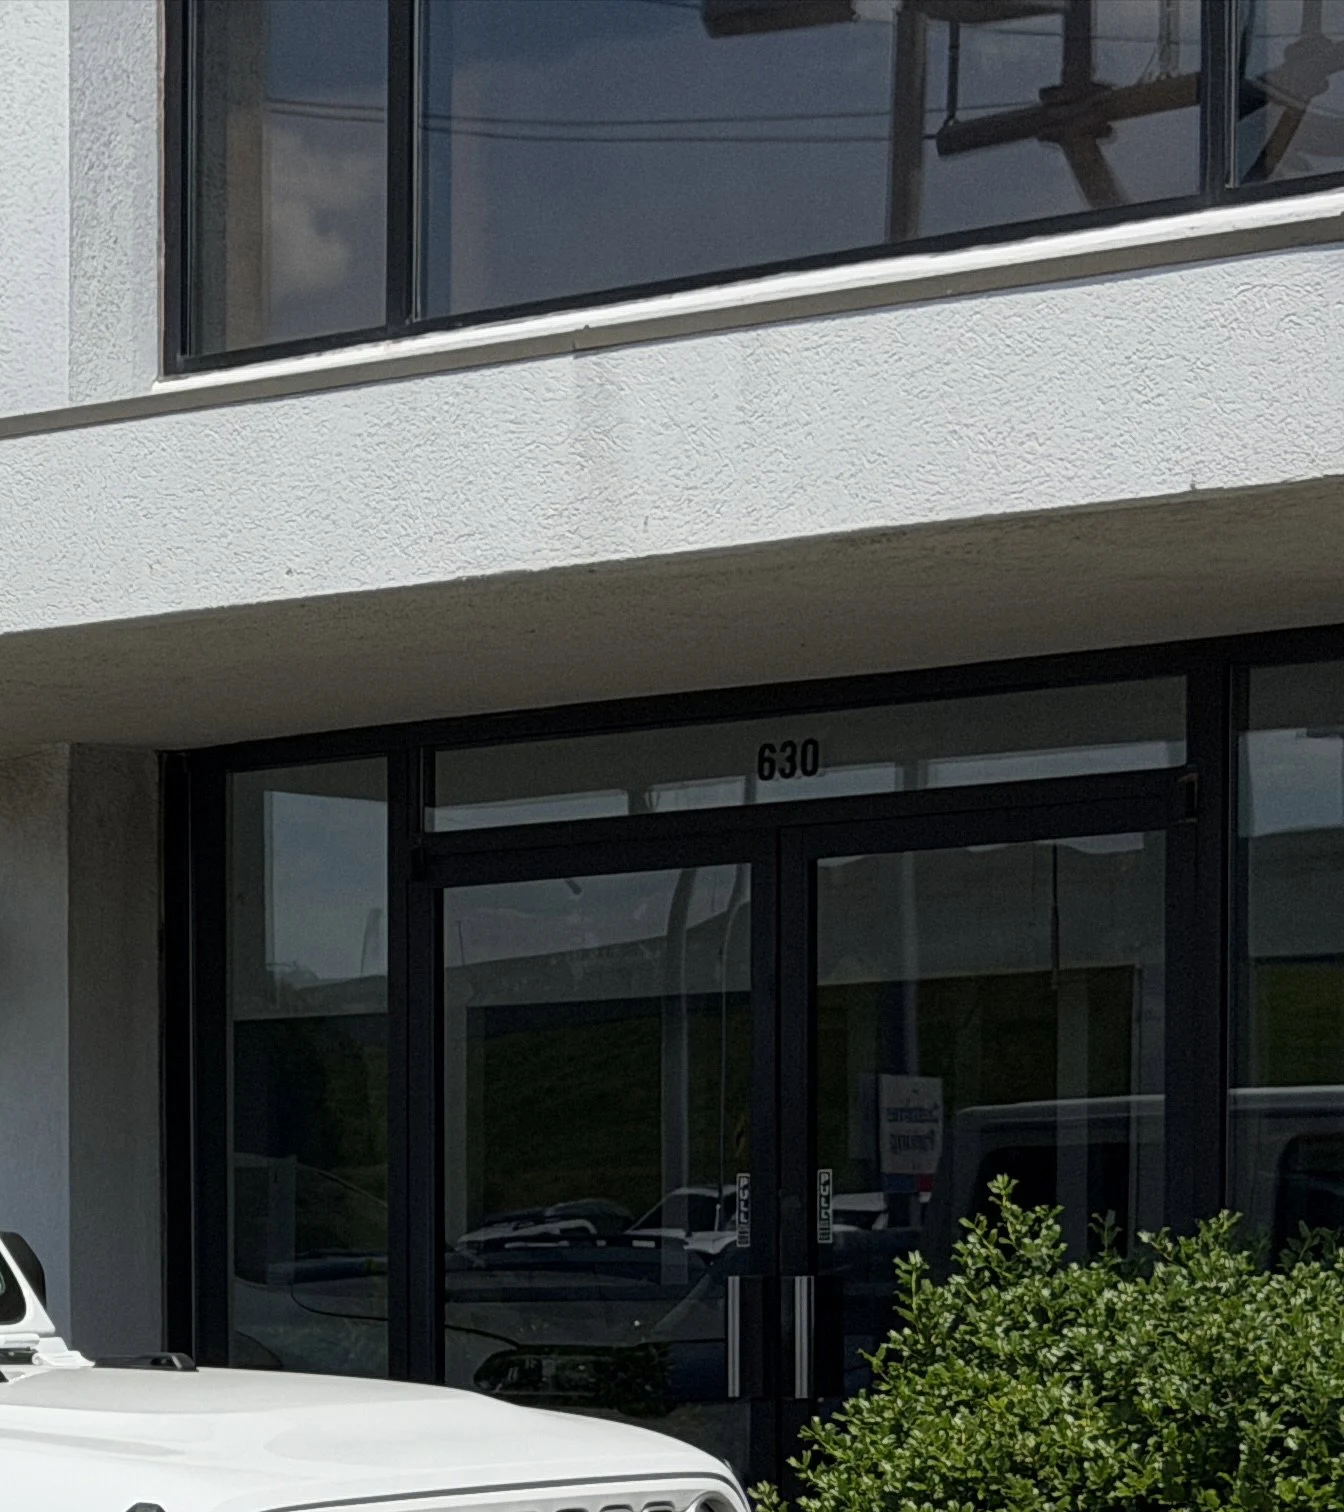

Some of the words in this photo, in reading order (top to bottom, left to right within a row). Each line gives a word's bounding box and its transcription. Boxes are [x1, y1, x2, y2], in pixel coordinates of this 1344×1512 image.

[758, 738, 819, 781] 630
[739, 1176, 750, 1224] PULL
[820, 1172, 830, 1219] PULL
